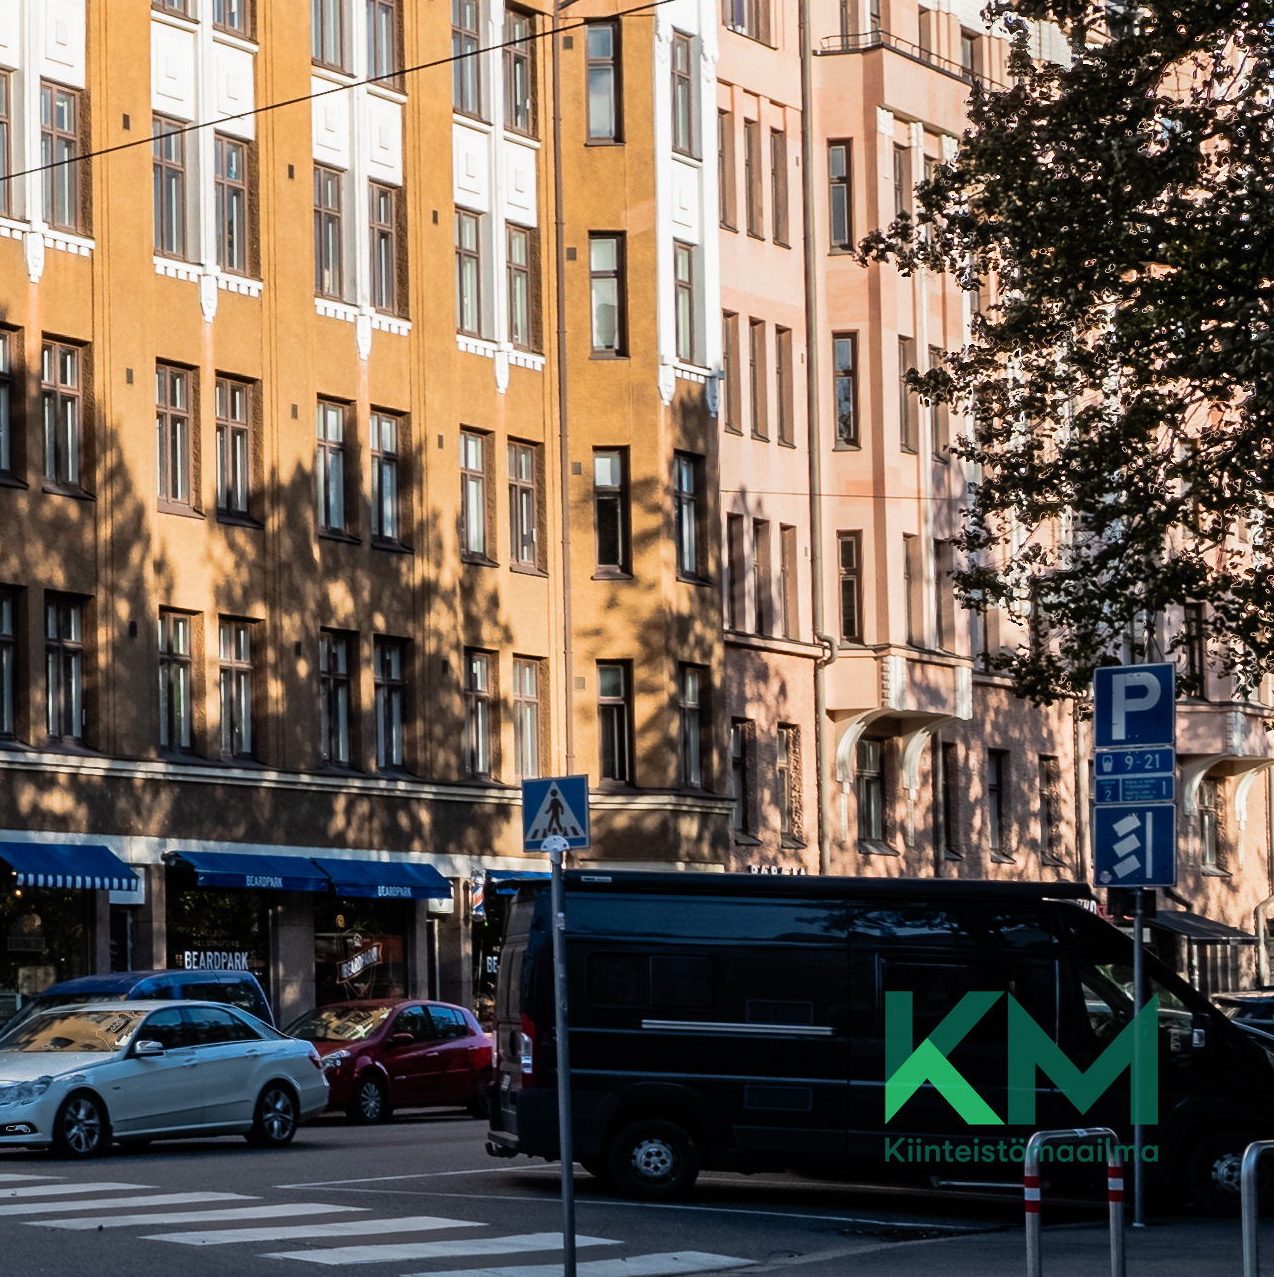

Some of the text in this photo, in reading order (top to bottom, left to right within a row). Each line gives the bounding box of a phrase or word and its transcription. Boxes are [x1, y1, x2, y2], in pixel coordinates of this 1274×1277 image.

[1112, 671, 1162, 740] P
[1124, 755, 1134, 770] 9
[1144, 753, 1160, 770] 21
[1104, 789, 1112, 802] 2
[246, 875, 283, 888] BEARDPARK
[377, 885, 412, 897] BEARDPARK
[184, 950, 249, 970] BEARDPARK
